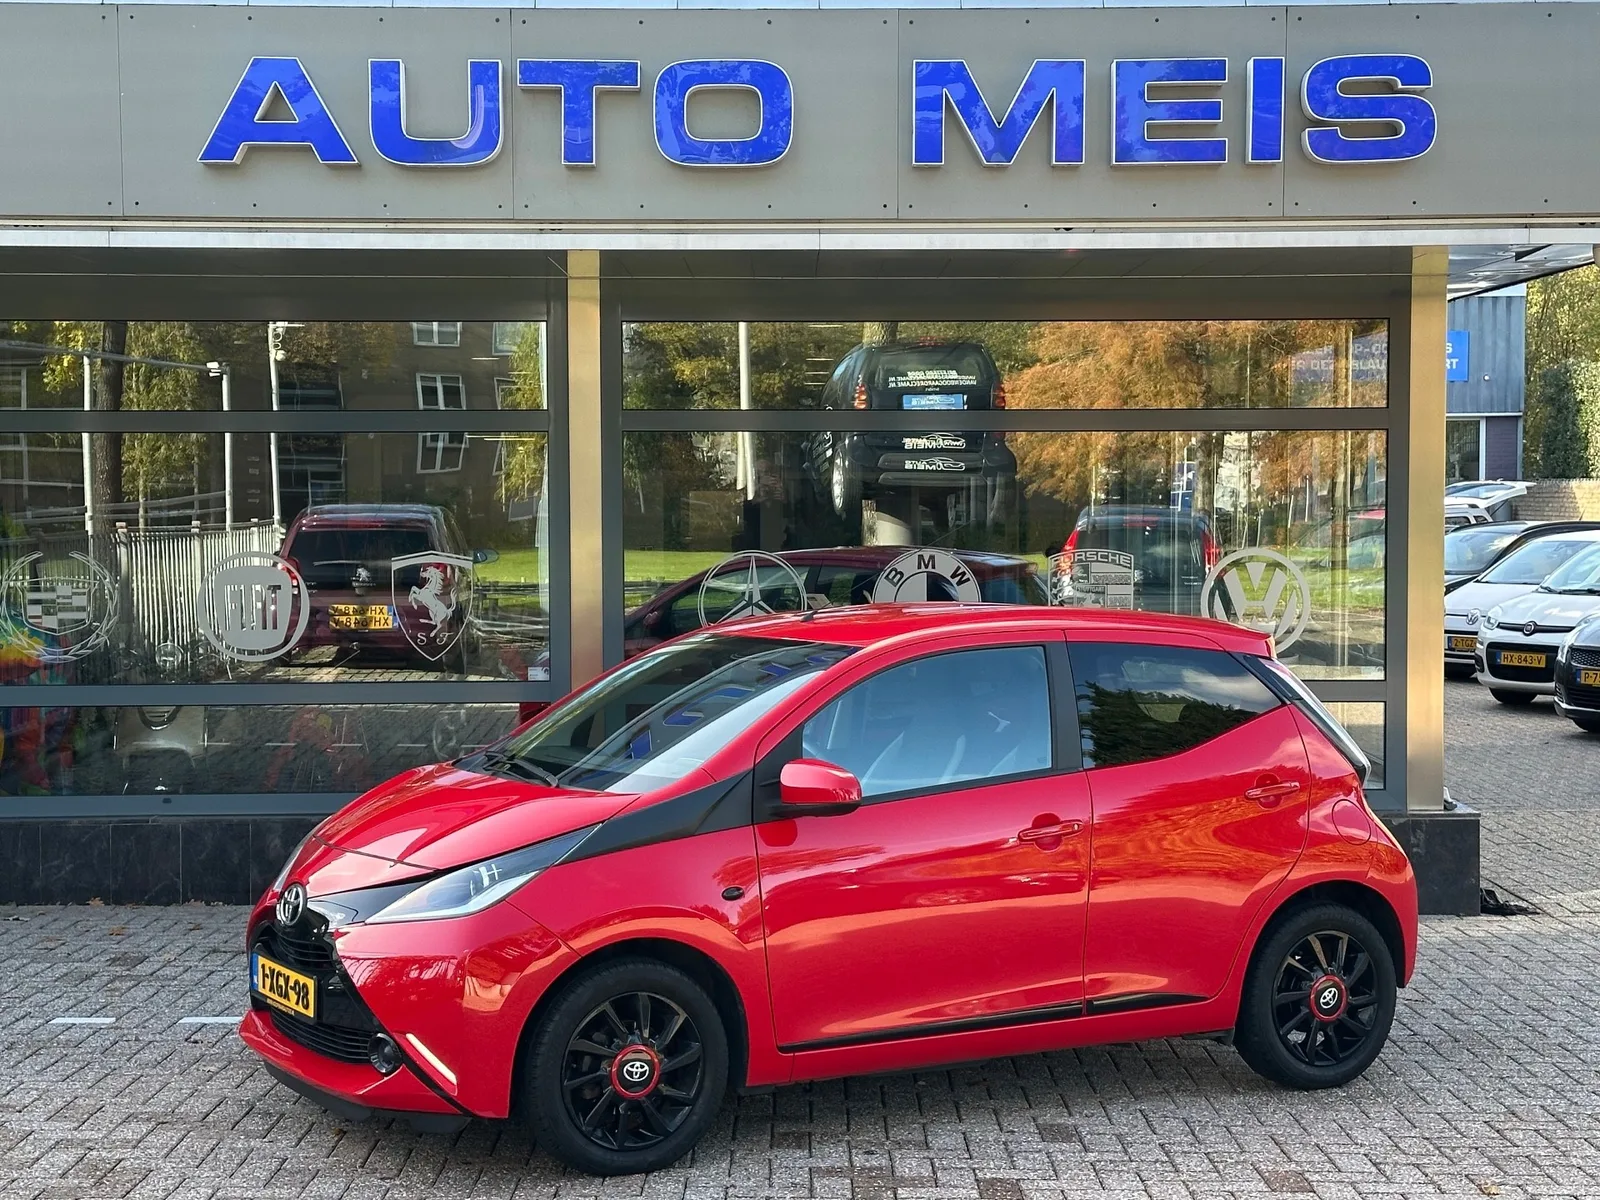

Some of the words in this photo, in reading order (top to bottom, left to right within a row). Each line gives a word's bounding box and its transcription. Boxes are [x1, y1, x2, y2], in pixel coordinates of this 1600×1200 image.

[197, 56, 795, 167] AUTO
[912, 53, 1438, 168] MEIS
[884, 554, 971, 587] BMW
[1052, 551, 1131, 568] PORSCHE
[224, 584, 281, 631] FIAT
[1503, 652, 1543, 666] HX-843-V
[260, 963, 310, 1010] 1-XGX-98
